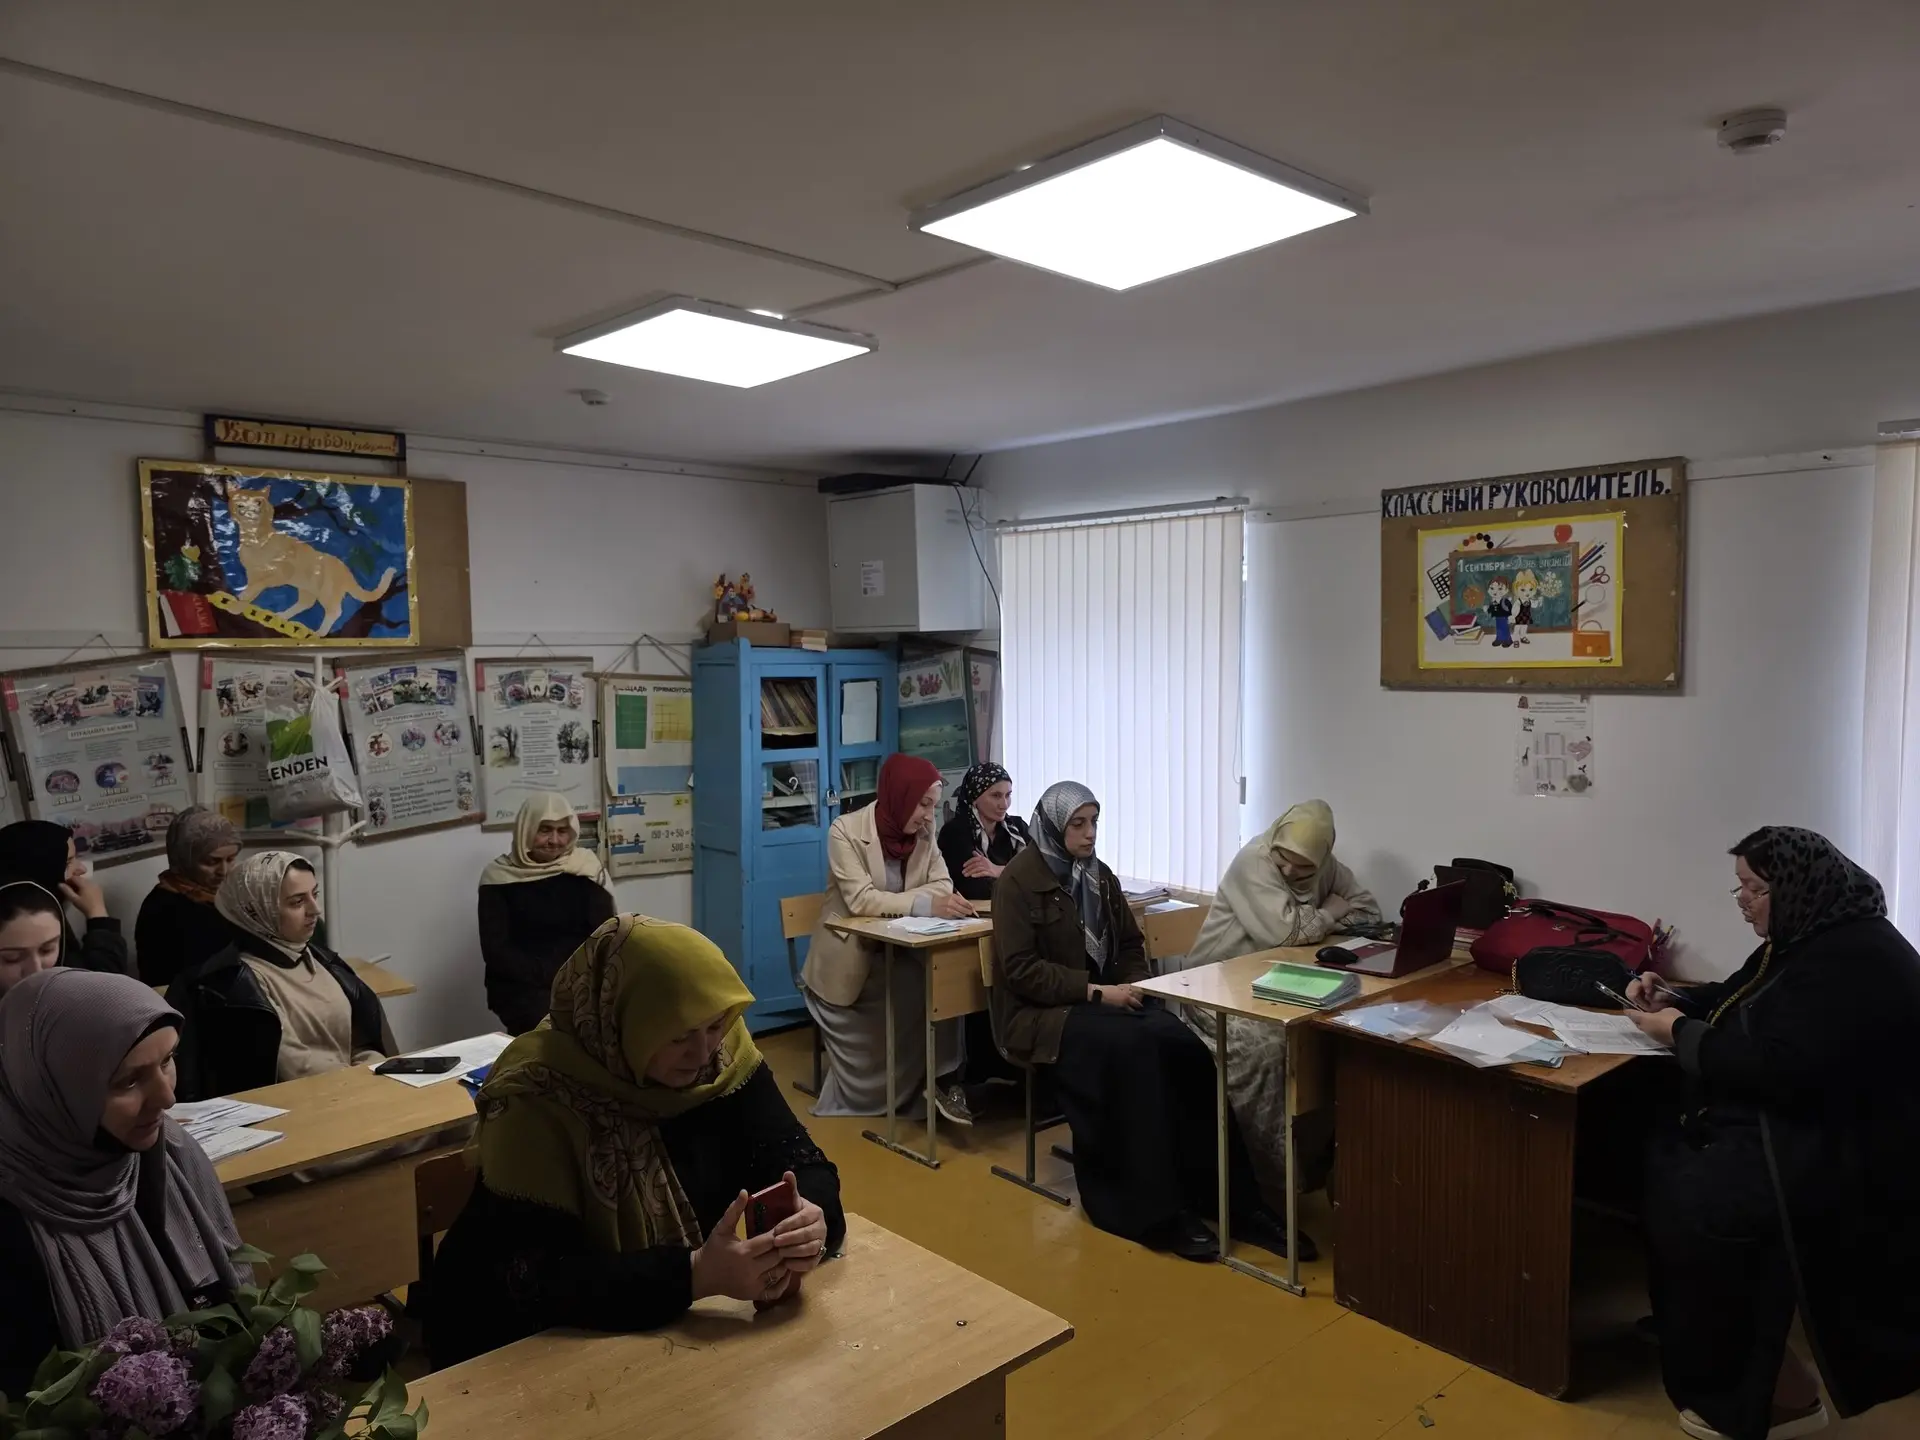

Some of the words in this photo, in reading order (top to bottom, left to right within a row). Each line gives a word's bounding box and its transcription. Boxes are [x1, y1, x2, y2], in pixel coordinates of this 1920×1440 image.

[1488, 469, 1671, 510] РУКОВОДИТЕЛЬ.
[1457, 559, 1465, 573] 1
[1464, 561, 1505, 573] СЕНТЯБРЯ
[266, 755, 329, 781] ENDEN
